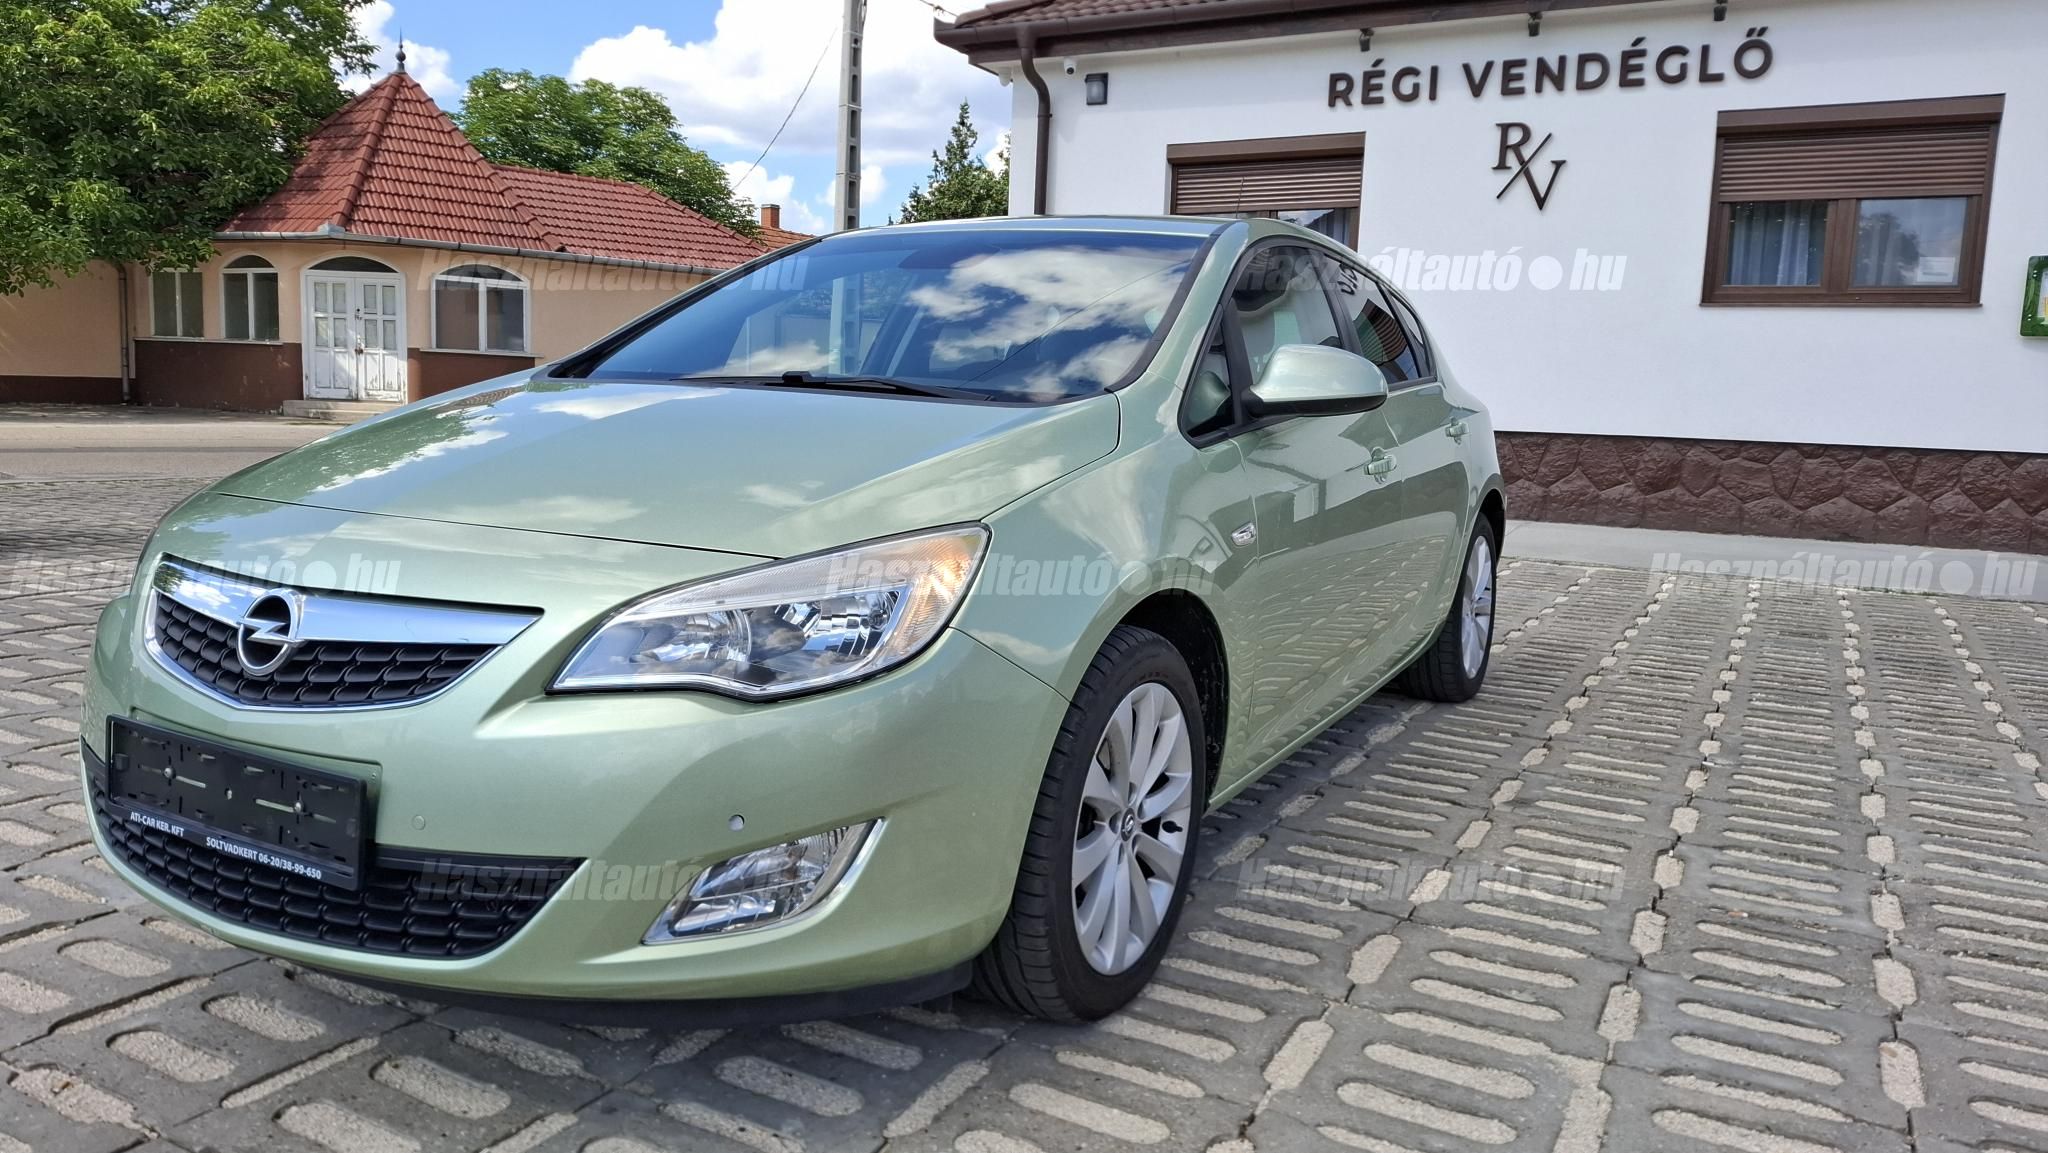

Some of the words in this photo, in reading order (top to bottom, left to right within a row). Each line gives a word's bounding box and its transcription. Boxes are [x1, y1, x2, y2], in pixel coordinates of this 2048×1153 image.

[1327, 58, 1439, 107] RÉGI
[1462, 26, 1773, 98] VENDÉGLŐ
[171, 826, 185, 837] KFT
[205, 836, 258, 861] SOLTVADKERT
